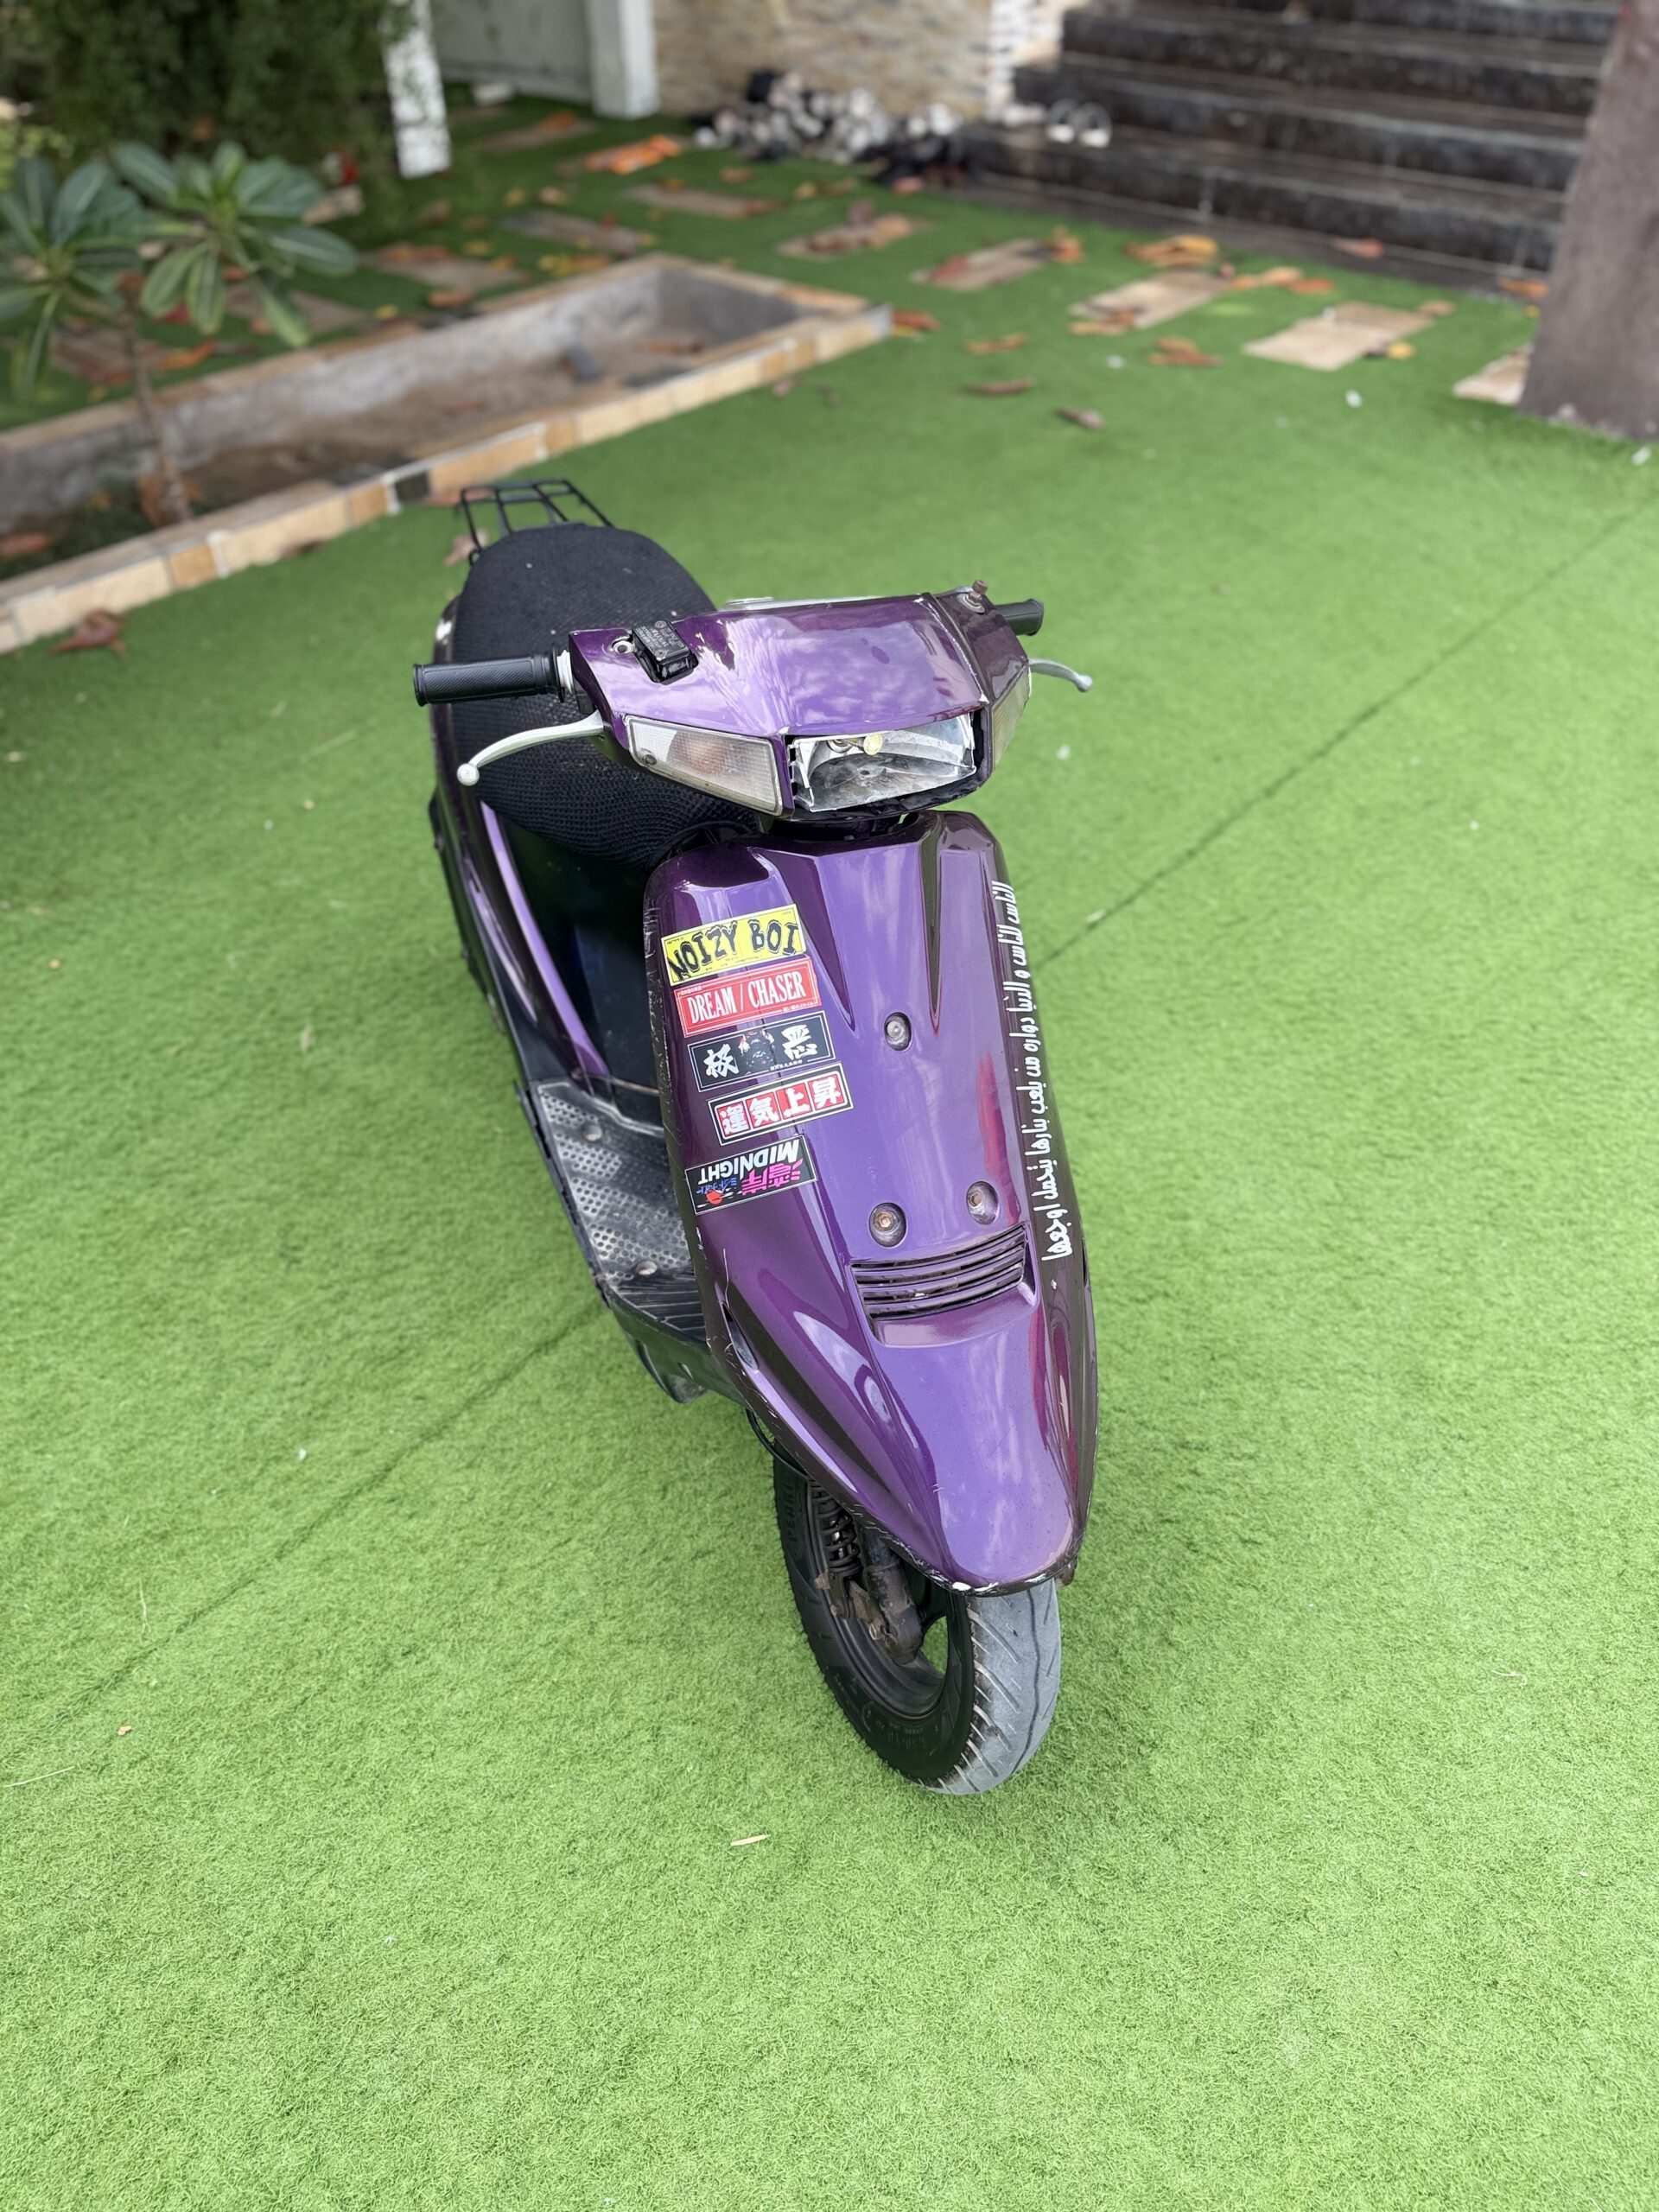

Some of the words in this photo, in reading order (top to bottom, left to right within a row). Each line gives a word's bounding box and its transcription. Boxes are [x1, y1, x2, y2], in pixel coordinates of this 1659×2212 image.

[991, 880, 1020, 925] الناس
[667, 919, 738, 982] NOIZY
[747, 918, 799, 956] BOI
[996, 924, 1027, 966] للناس
[1013, 969, 1031, 979] و
[687, 986, 738, 1024] DREAM
[747, 971, 807, 1008] CHASER
[1002, 981, 1037, 1012] الدنيا
[1008, 1017, 1041, 1052] دواره
[1014, 1056, 1041, 1077] من
[1015, 1081, 1048, 1115] يلعب
[1020, 1118, 1052, 1156] بنارها
[698, 1139, 800, 1185] MIDNIGHT
[1027, 1159, 1058, 1200] يتحمل
[1033, 1203, 1073, 1262] اوجعها
